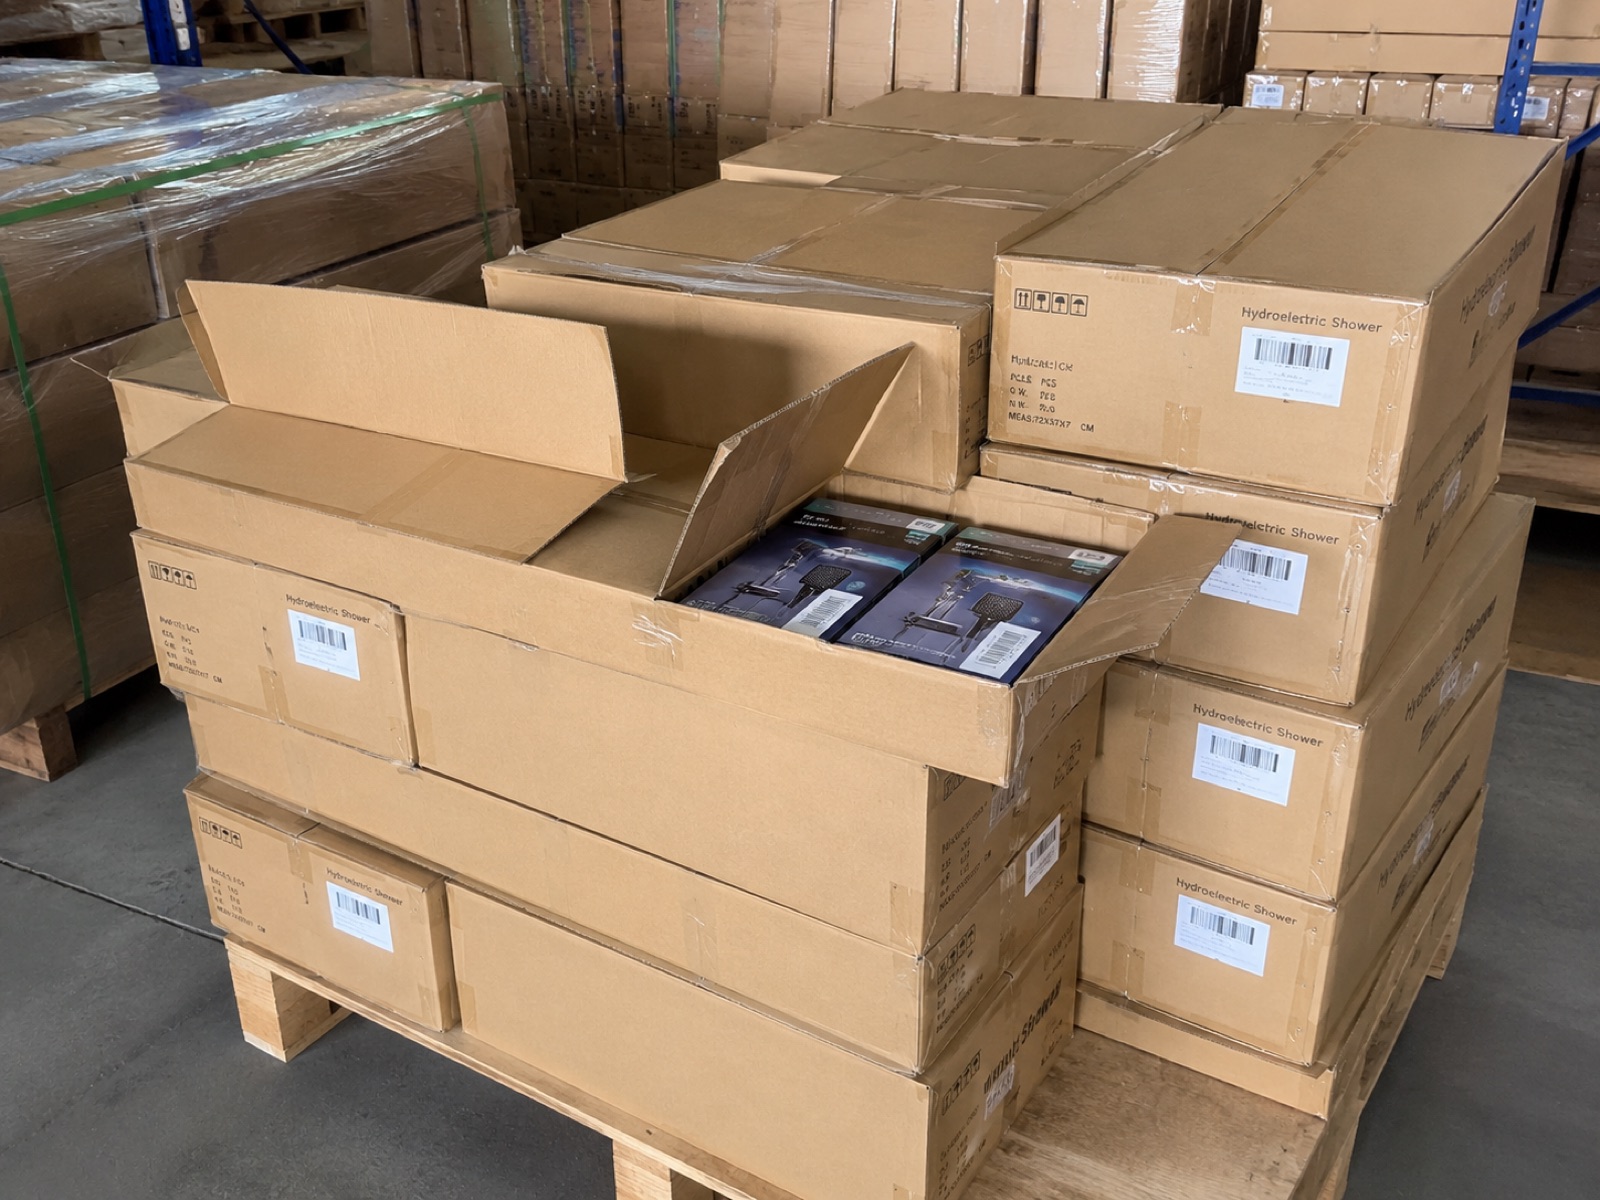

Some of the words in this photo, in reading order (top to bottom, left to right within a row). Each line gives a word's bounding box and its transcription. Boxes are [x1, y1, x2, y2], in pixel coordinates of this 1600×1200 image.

[1332, 317, 1383, 333] Shower
[1080, 423, 1095, 432] CM
[1291, 527, 1340, 545] Shower
[1277, 727, 1324, 748] Shower
[1176, 877, 1251, 910] Hydroelectric
[1254, 904, 1298, 926] Shower
